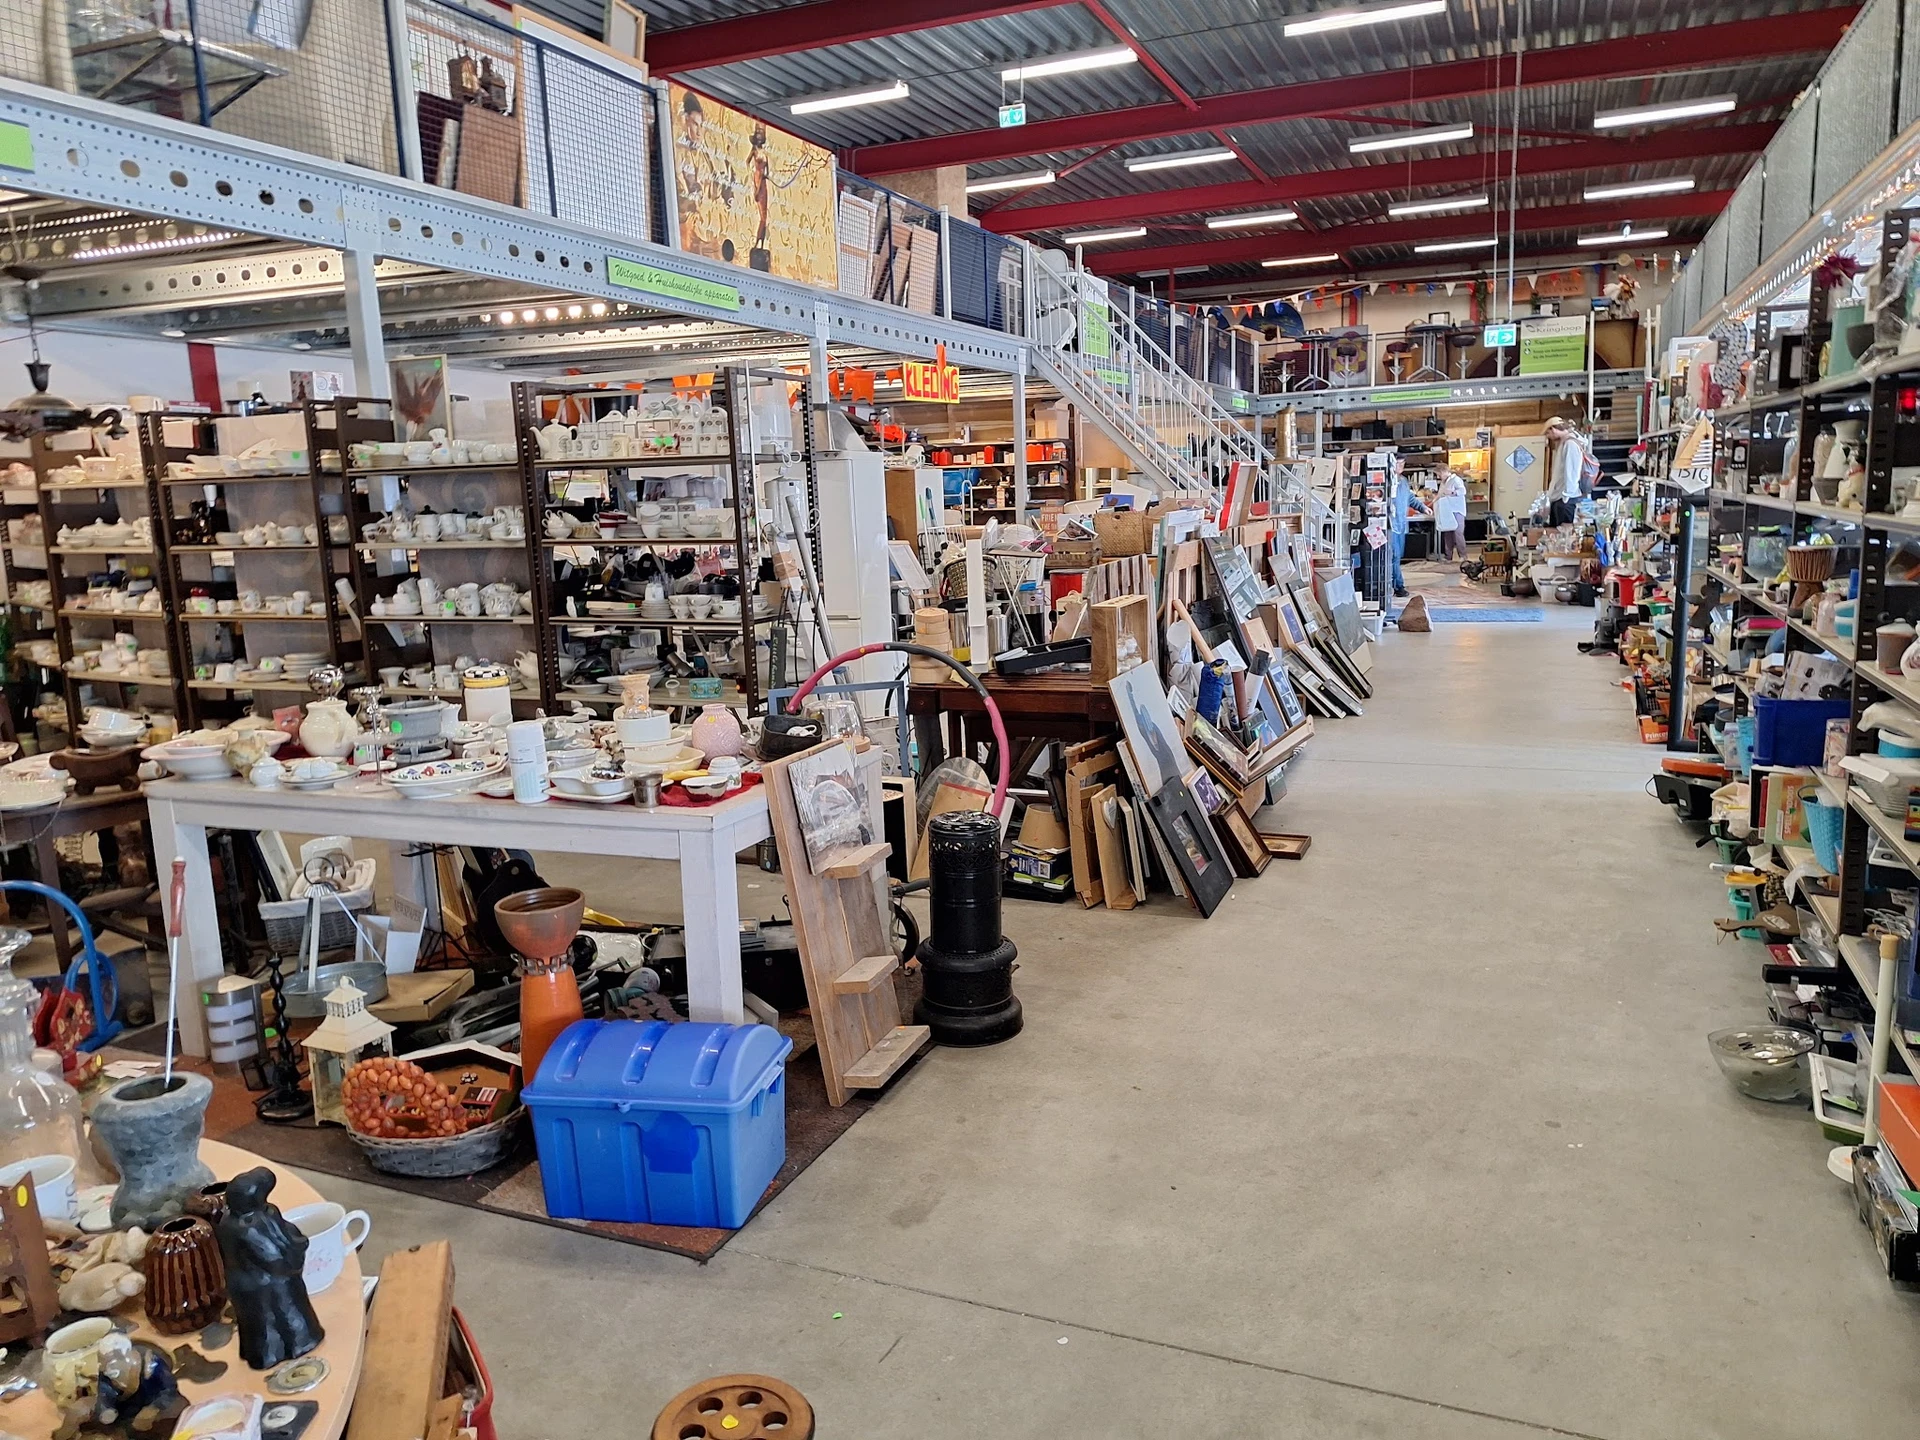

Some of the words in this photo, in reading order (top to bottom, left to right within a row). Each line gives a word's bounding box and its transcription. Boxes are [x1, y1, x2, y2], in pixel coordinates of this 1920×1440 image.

[614, 264, 645, 283] Witgoed
[648, 272, 653, 282] &
[704, 288, 735, 303] apparaten
[905, 363, 959, 401] KLEDING
